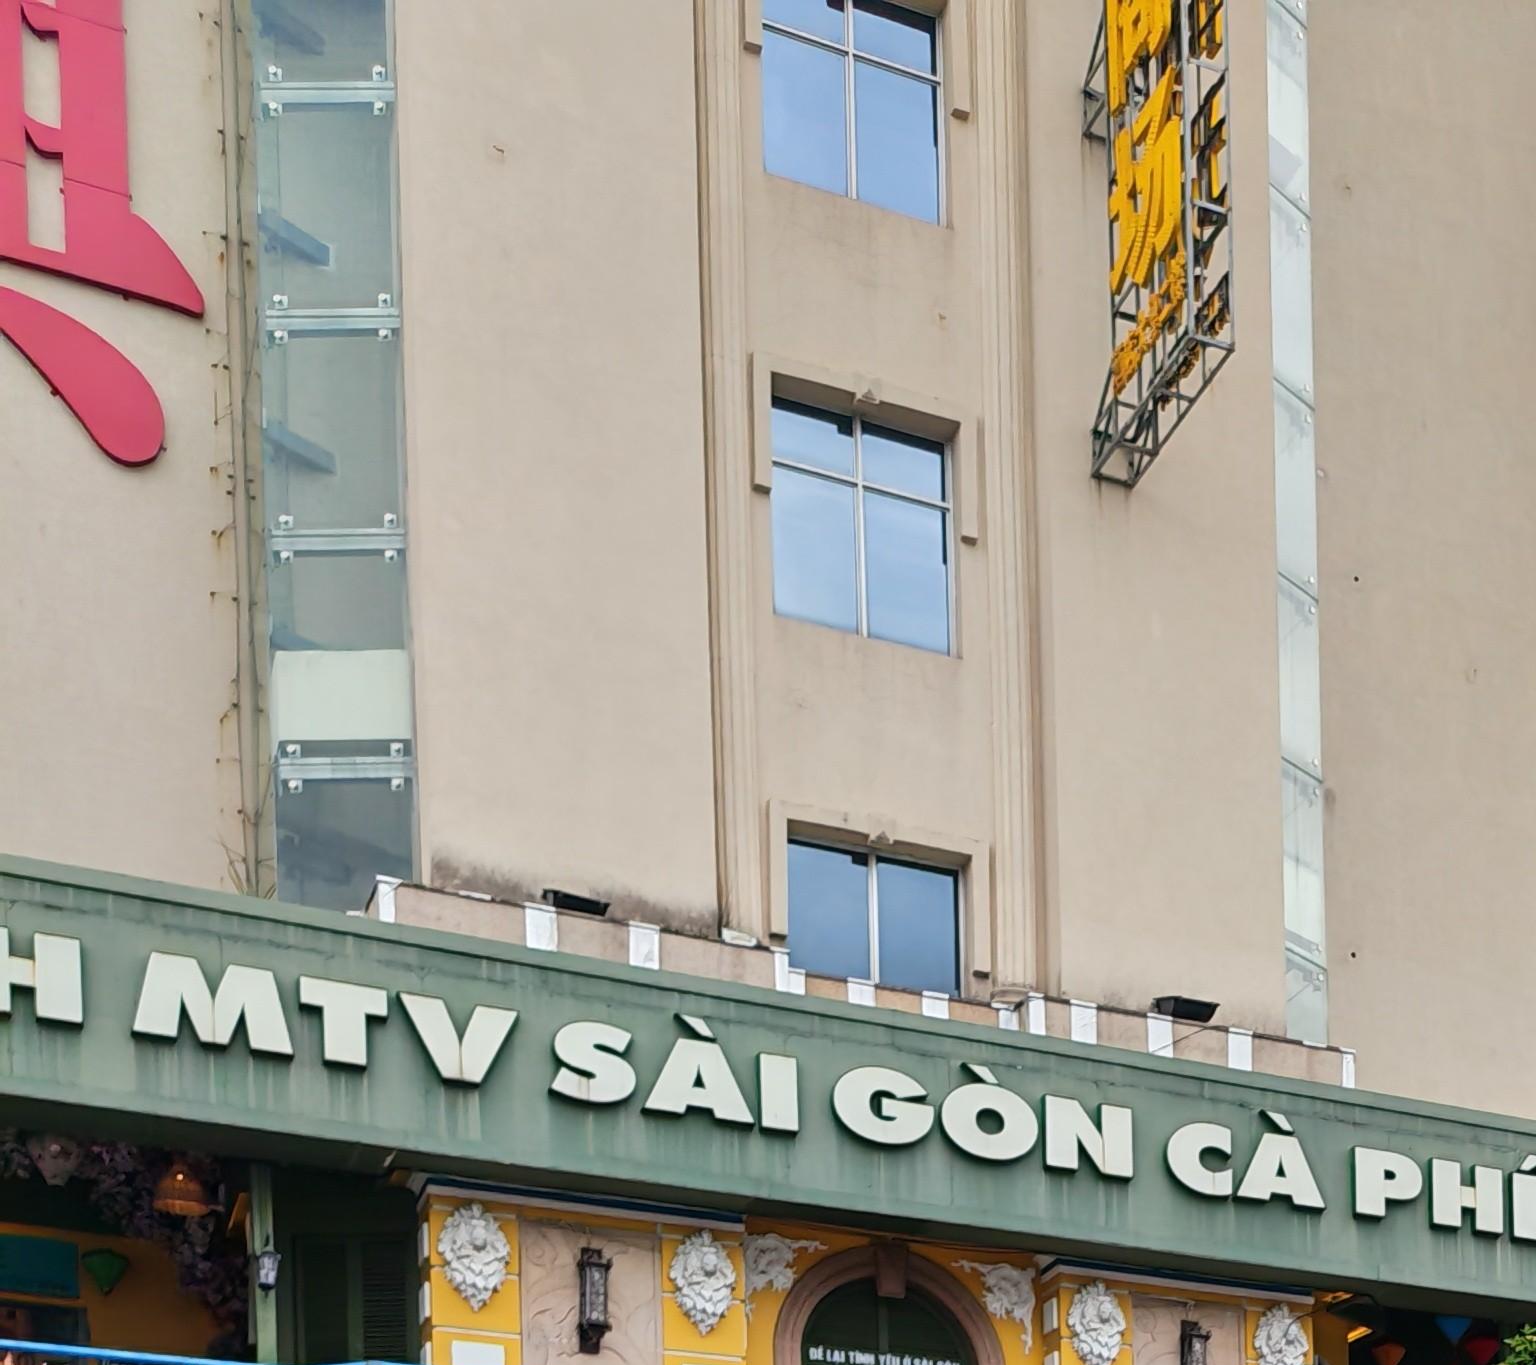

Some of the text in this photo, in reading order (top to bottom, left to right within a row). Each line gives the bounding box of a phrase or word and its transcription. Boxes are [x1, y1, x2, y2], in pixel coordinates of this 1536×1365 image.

[131, 951, 519, 1085] MTV
[548, 1012, 800, 1134] SÀI
[832, 1062, 1134, 1180] GÒN
[1167, 1110, 1326, 1212] CÀ
